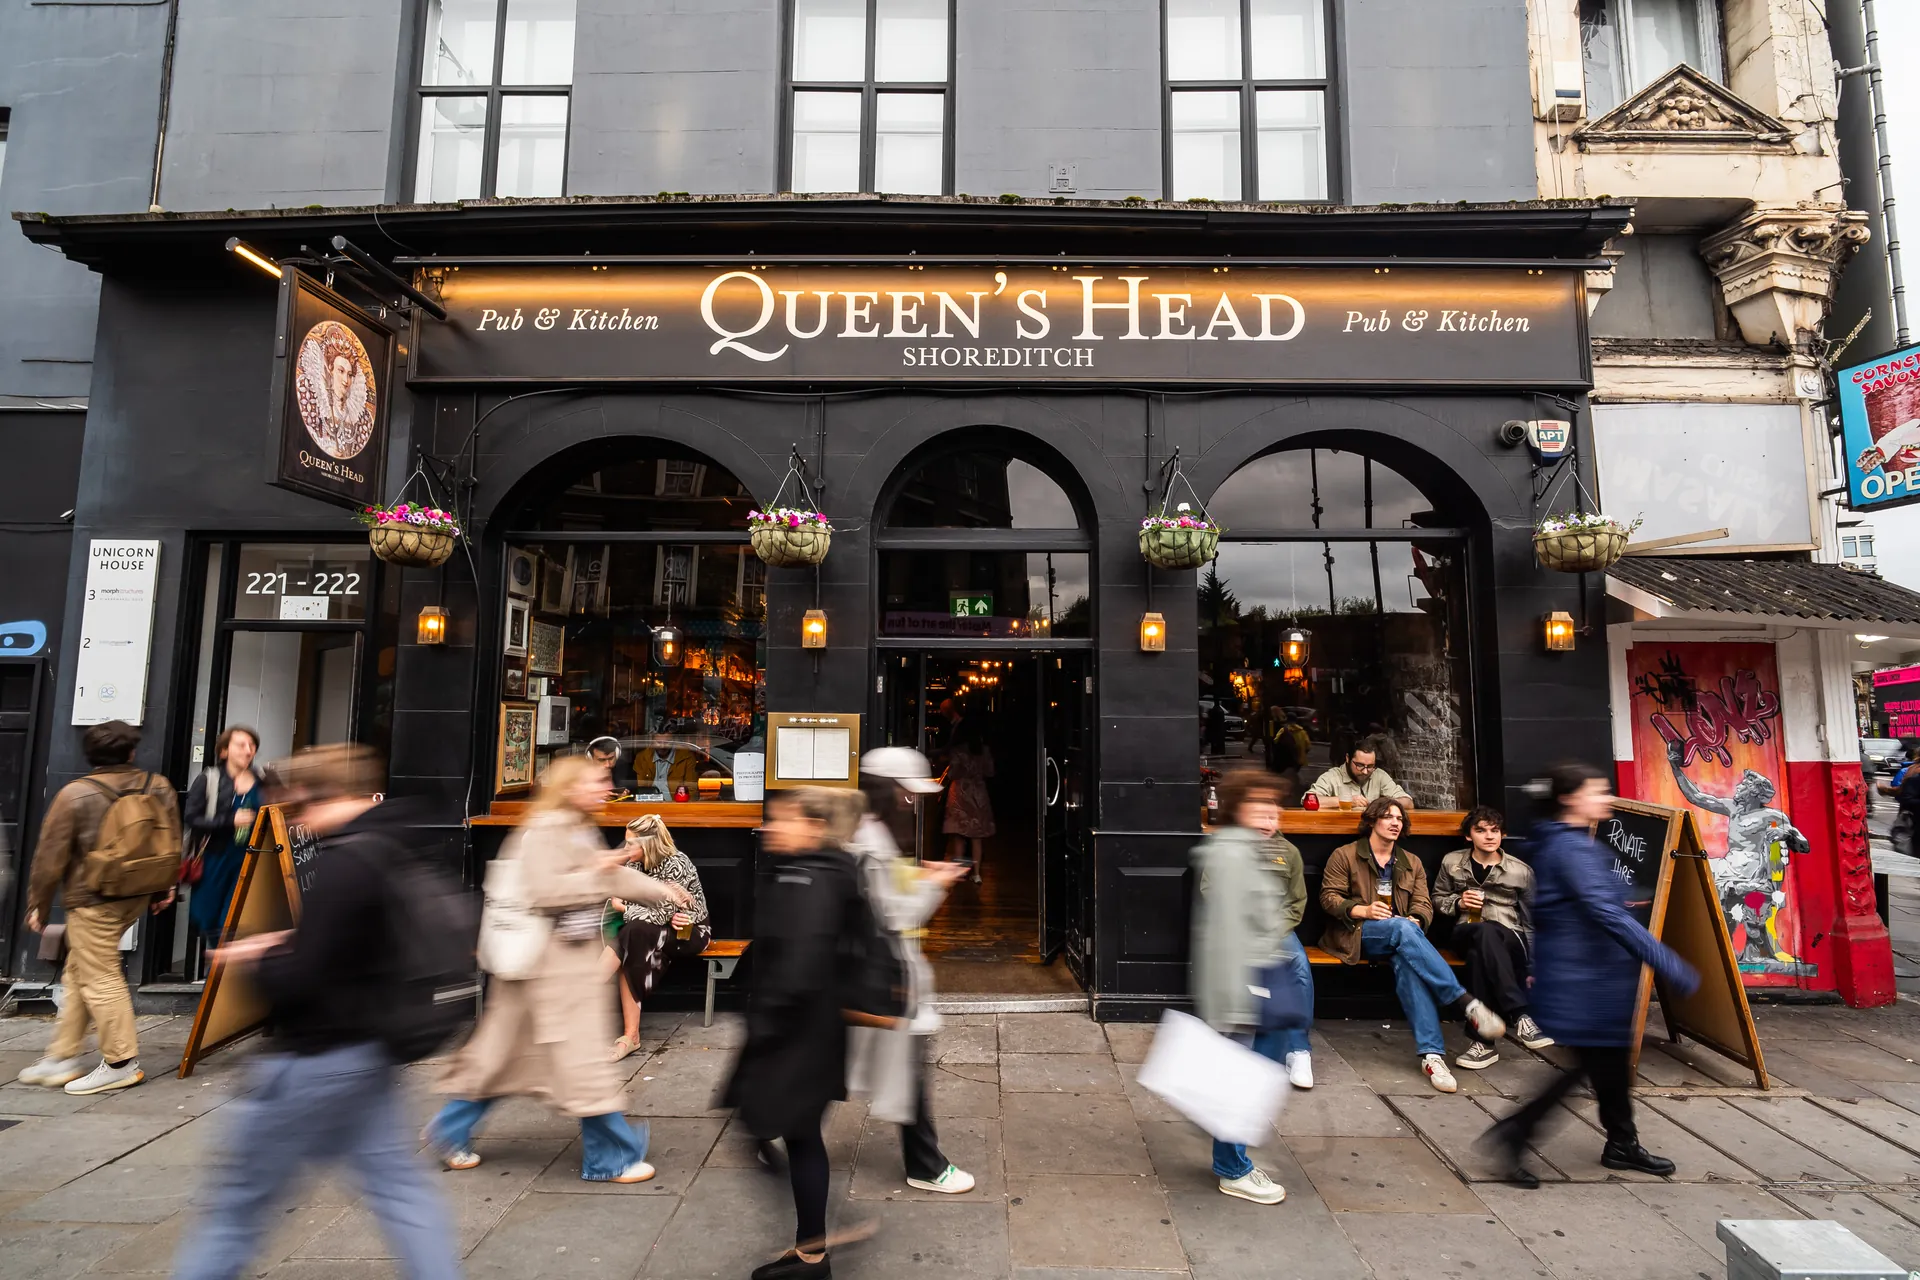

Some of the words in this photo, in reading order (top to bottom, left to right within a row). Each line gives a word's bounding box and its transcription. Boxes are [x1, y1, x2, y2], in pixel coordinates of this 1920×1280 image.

[476, 308, 524, 333] Pub
[534, 308, 561, 331] &
[567, 307, 660, 332] Kitchen
[700, 271, 1049, 363] QUEEN'S
[1072, 275, 1306, 342] HEAD
[1343, 310, 1391, 334] Pub
[1402, 309, 1429, 333] &
[1437, 309, 1531, 333] Kitchen
[902, 346, 1095, 368] SHOREDITCH
[1539, 431, 1563, 441] APT
[299, 450, 339, 475] QUEEN'S
[341, 464, 364, 483] HEAD
[93, 547, 155, 558] UNICORN
[100, 560, 145, 570] HOUSE
[88, 589, 96, 601] 3
[246, 573, 288, 595] 221
[313, 573, 360, 595] 222
[83, 637, 91, 649] 2
[79, 686, 84, 698] 1
[1607, 818, 1648, 863] PRIVATE
[1610, 858, 1635, 886] HIRE
